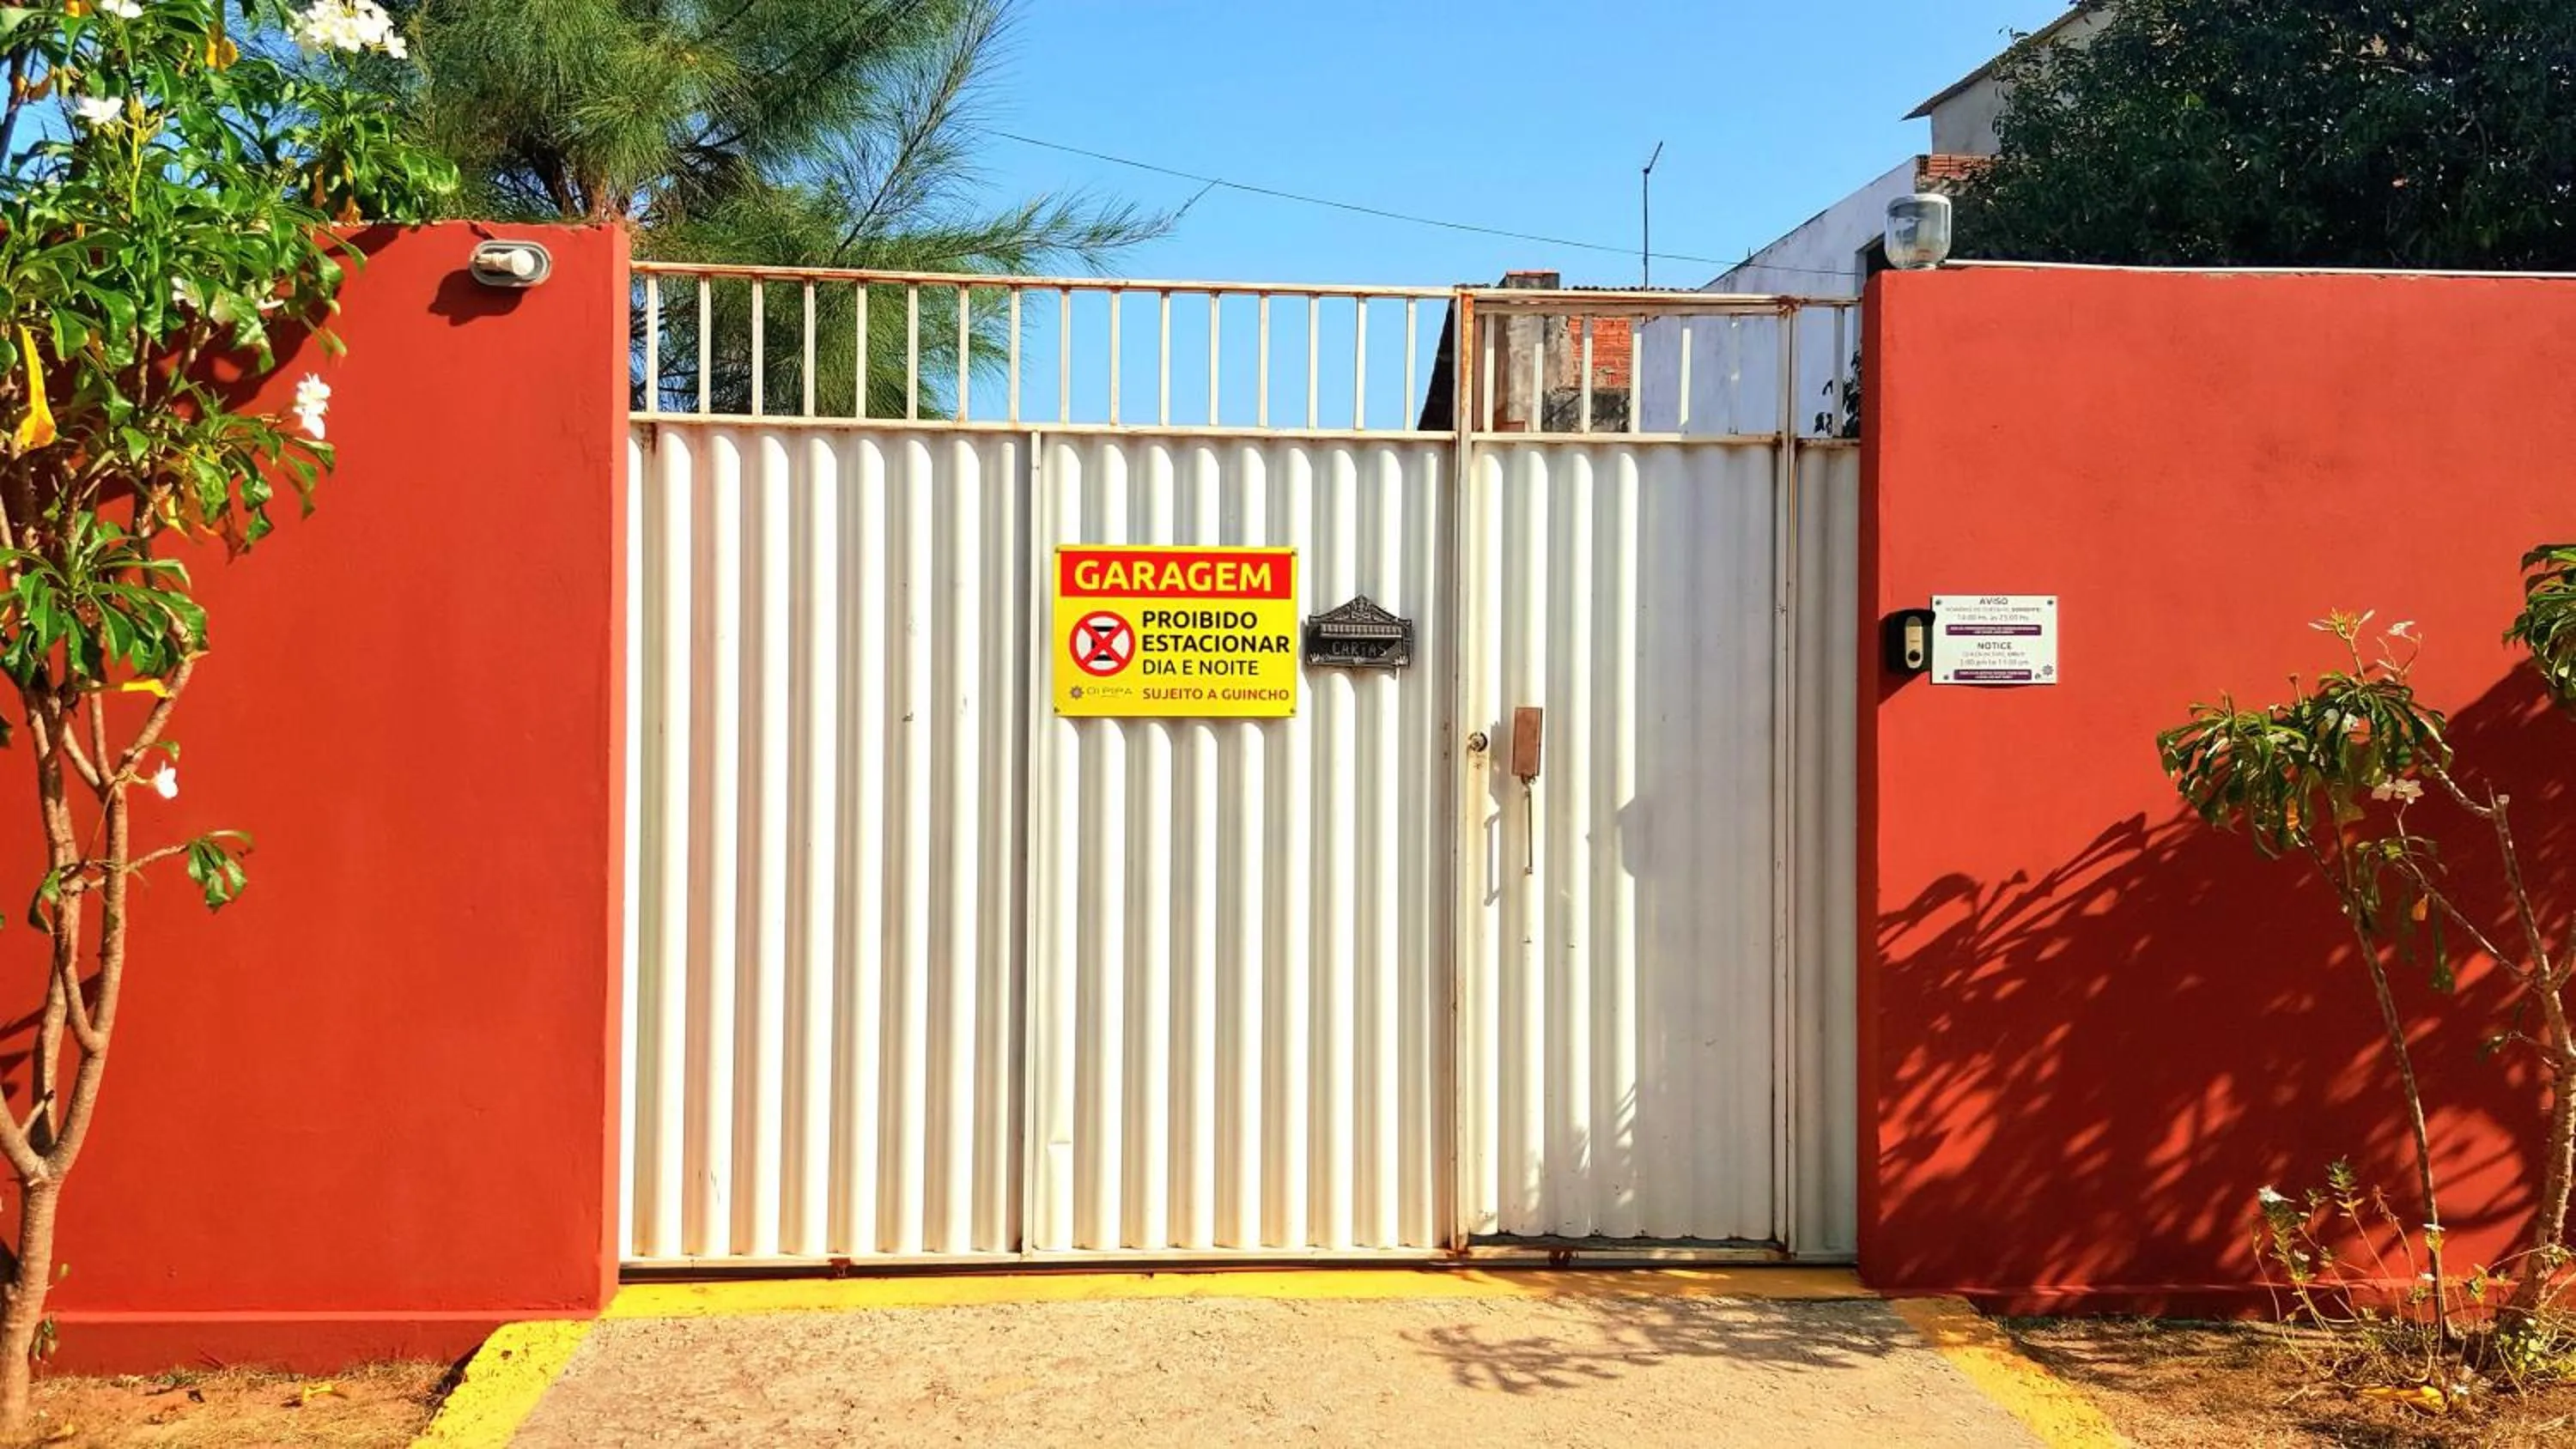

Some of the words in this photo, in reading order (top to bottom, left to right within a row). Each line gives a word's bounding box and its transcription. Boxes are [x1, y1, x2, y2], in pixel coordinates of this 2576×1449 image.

[1074, 560, 1272, 591] GARAGEM
[1142, 610, 1258, 629] PROIBIDO
[1142, 634, 1291, 653] ESTACIONAR
[1332, 641, 1387, 657] CARTAS
[1143, 658, 1176, 675] DIA
[1182, 659, 1193, 676] E
[1200, 659, 1260, 676] NOITE
[1143, 688, 1203, 700] SUJEITO
[1207, 688, 1218, 700] A
[1221, 688, 1290, 700] GUINCHO
